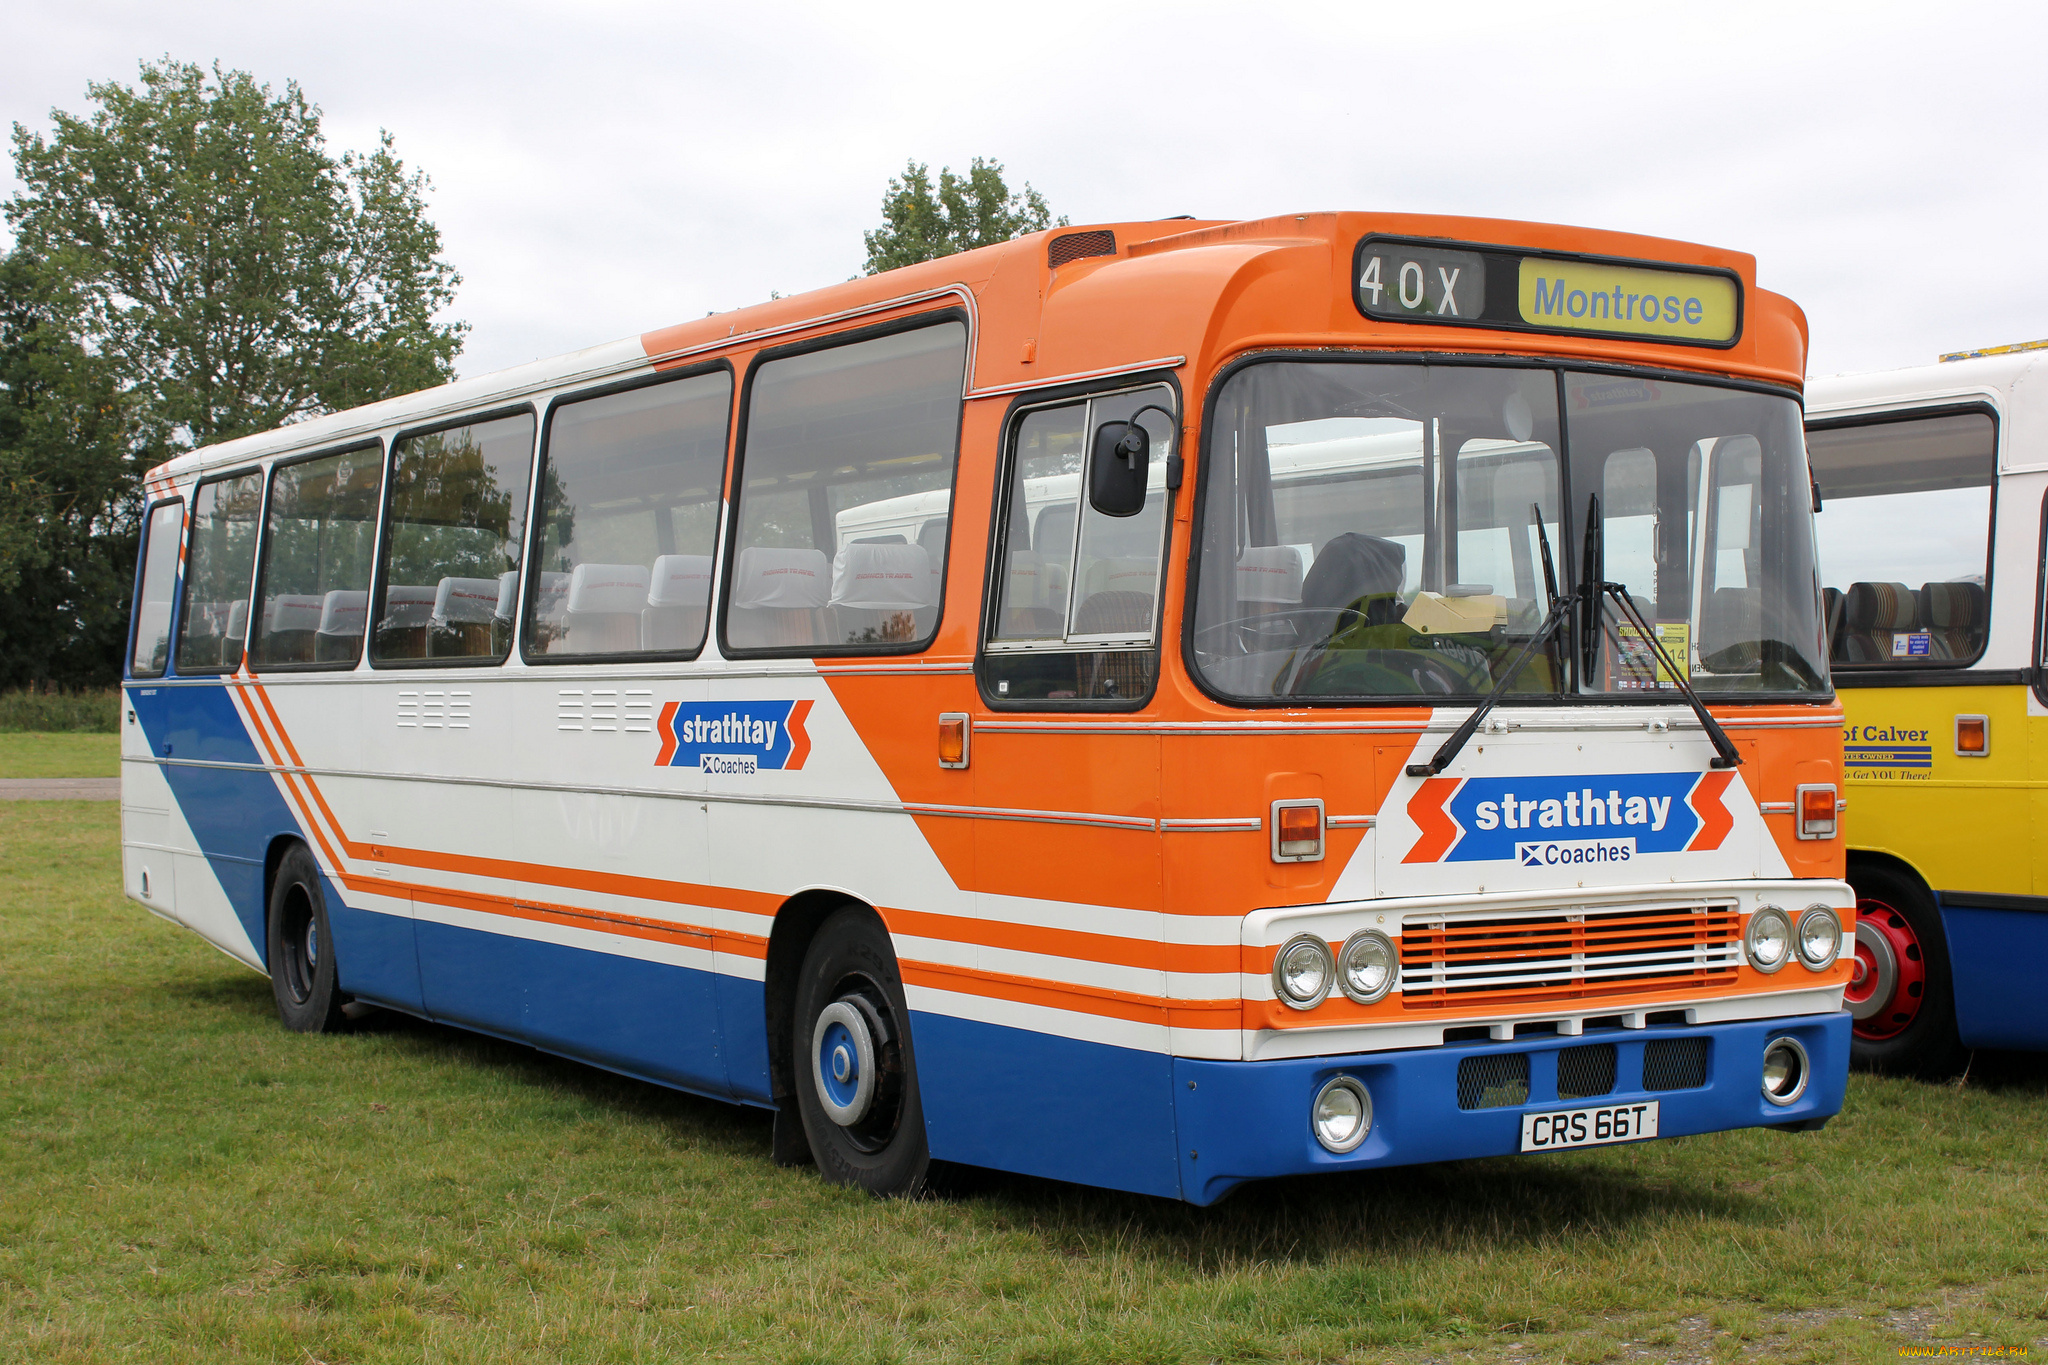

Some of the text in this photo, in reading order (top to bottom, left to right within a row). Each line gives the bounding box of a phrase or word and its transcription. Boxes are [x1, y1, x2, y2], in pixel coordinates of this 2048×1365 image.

[1533, 277, 1703, 325] Montrose
[683, 713, 778, 751] strathtay
[1863, 726, 1928, 741] Calver
[713, 756, 756, 774] Coaches
[1853, 770, 1869, 780] Get
[1872, 771, 1896, 780] YOU
[1900, 770, 1932, 781] There!
[1475, 788, 1672, 832] strathtay
[1544, 842, 1631, 867] Coaches
[1532, 1106, 1647, 1146] CRS 66T
